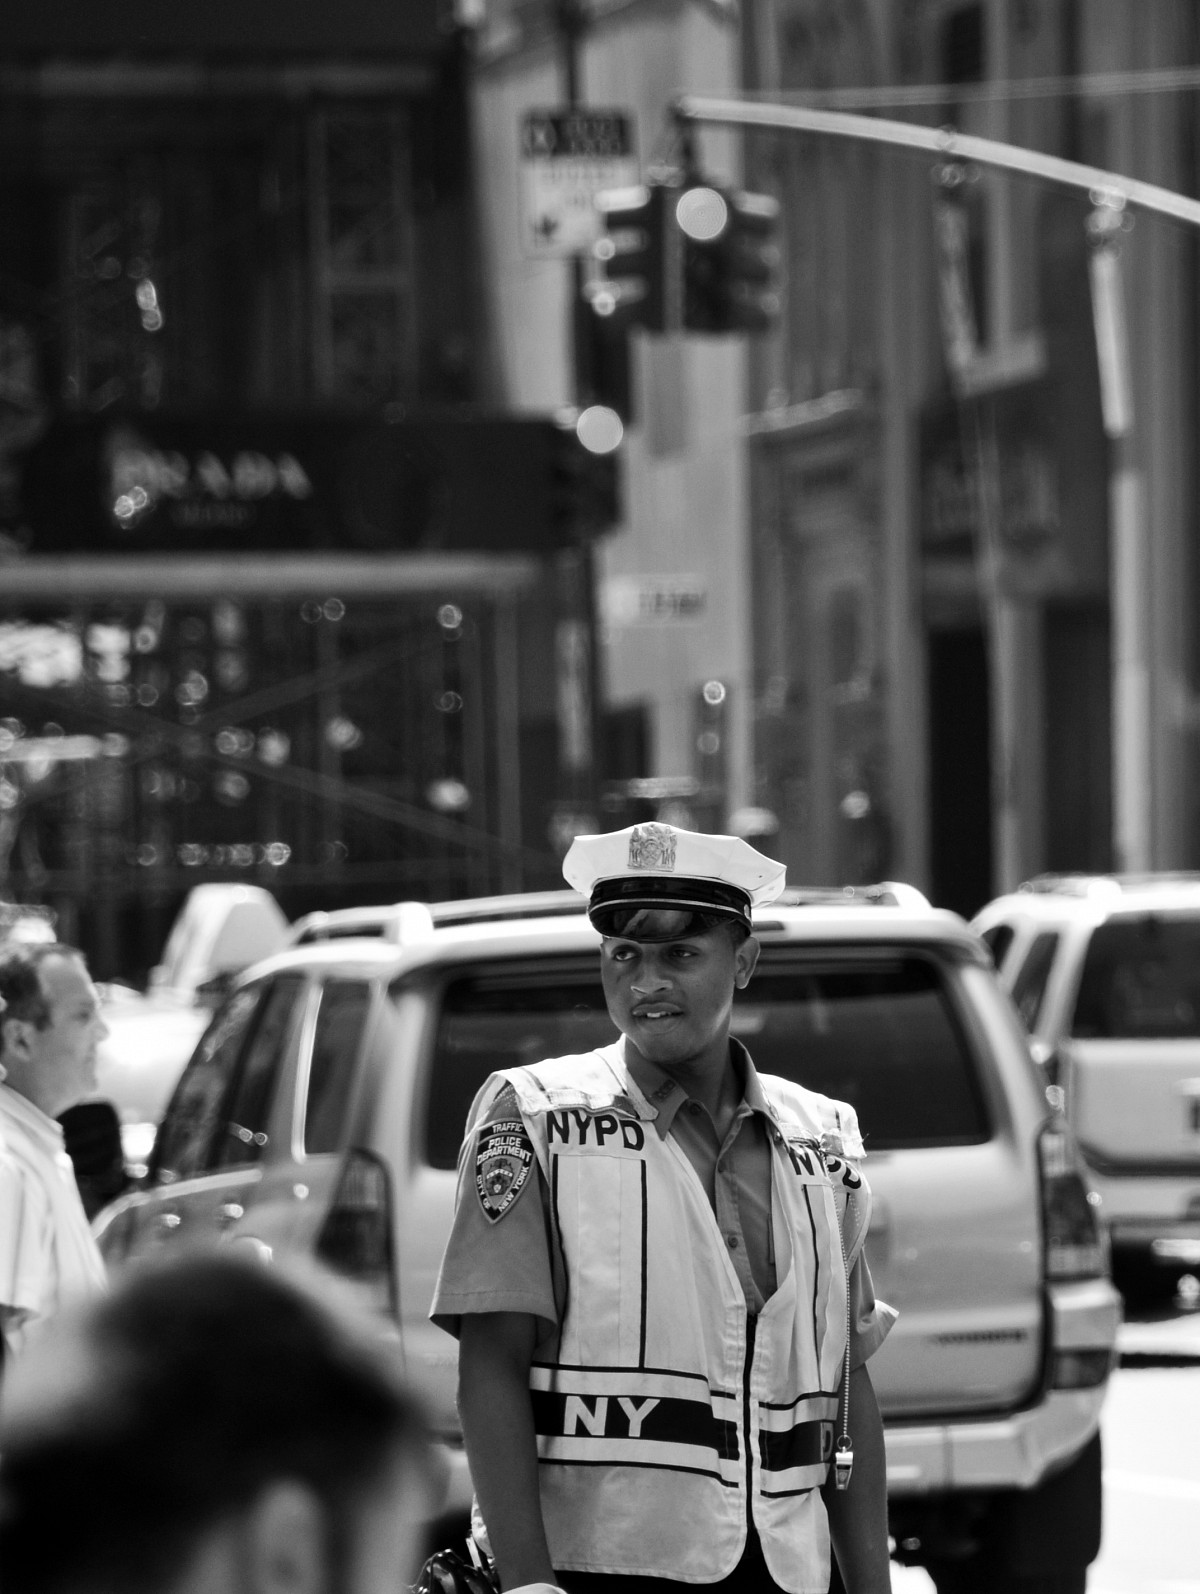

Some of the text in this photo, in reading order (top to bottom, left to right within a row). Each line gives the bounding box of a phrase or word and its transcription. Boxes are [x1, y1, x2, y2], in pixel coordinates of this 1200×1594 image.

[488, 1136, 522, 1149] POLICE
[493, 1122, 524, 1133] TRAFFIC
[547, 1110, 644, 1151] NYPD
[477, 1146, 531, 1165] DEPARTMENT
[498, 1166, 529, 1212] NEW YORK
[563, 1395, 661, 1438] NY
